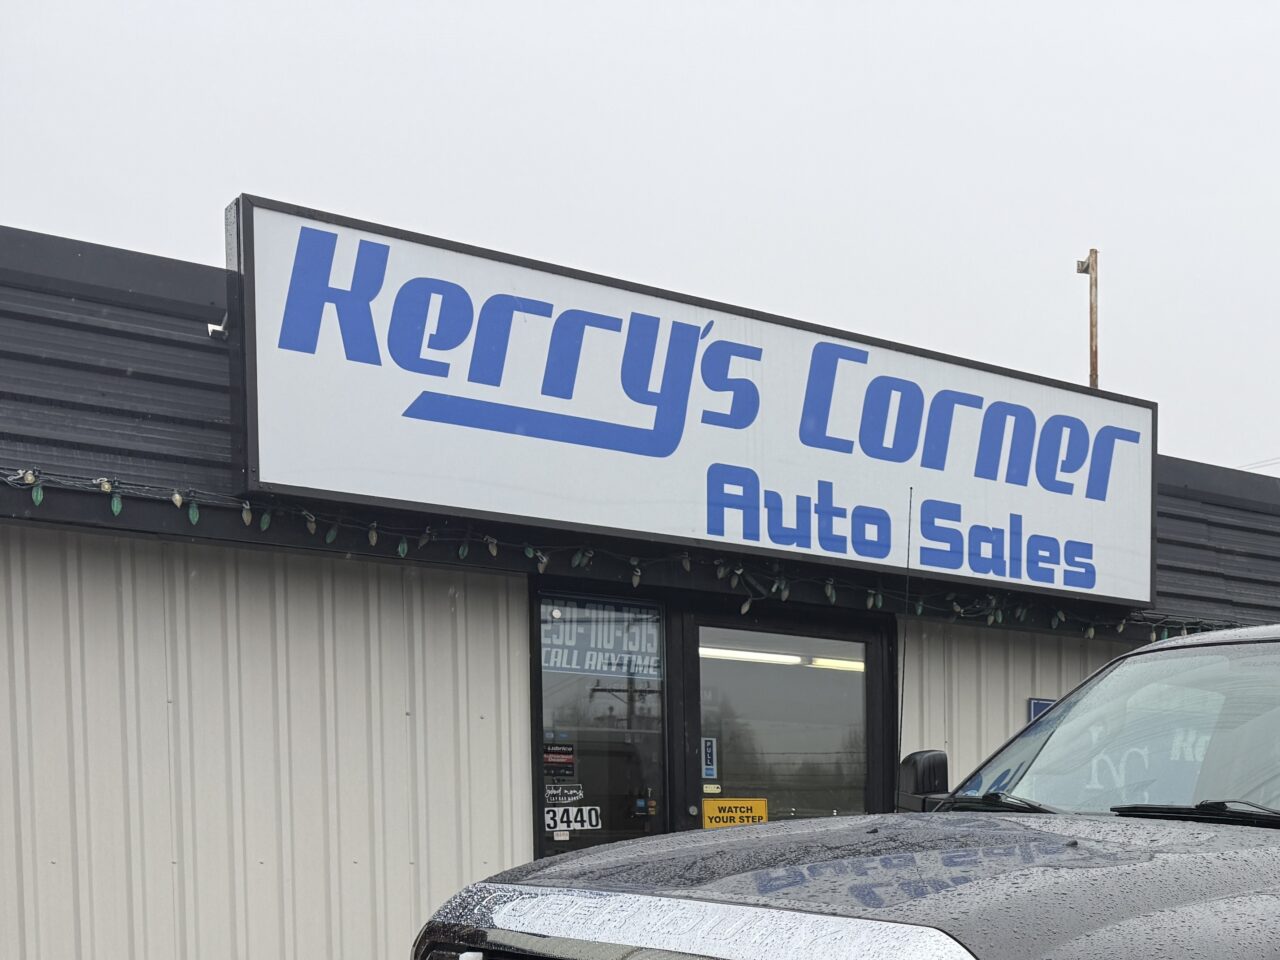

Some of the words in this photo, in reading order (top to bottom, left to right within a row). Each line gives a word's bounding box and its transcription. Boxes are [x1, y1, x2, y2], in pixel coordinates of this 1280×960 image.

[278, 226, 763, 458] Kerry's
[799, 341, 1141, 501] Corner
[706, 462, 892, 560] Auto
[919, 499, 1096, 590] Sales
[542, 647, 581, 669] CALL
[584, 651, 660, 674] ANYTIME
[545, 807, 600, 830] 3440
[708, 815, 736, 824] YOUR
[738, 815, 764, 824] STEP
[717, 806, 753, 814] WATCH
